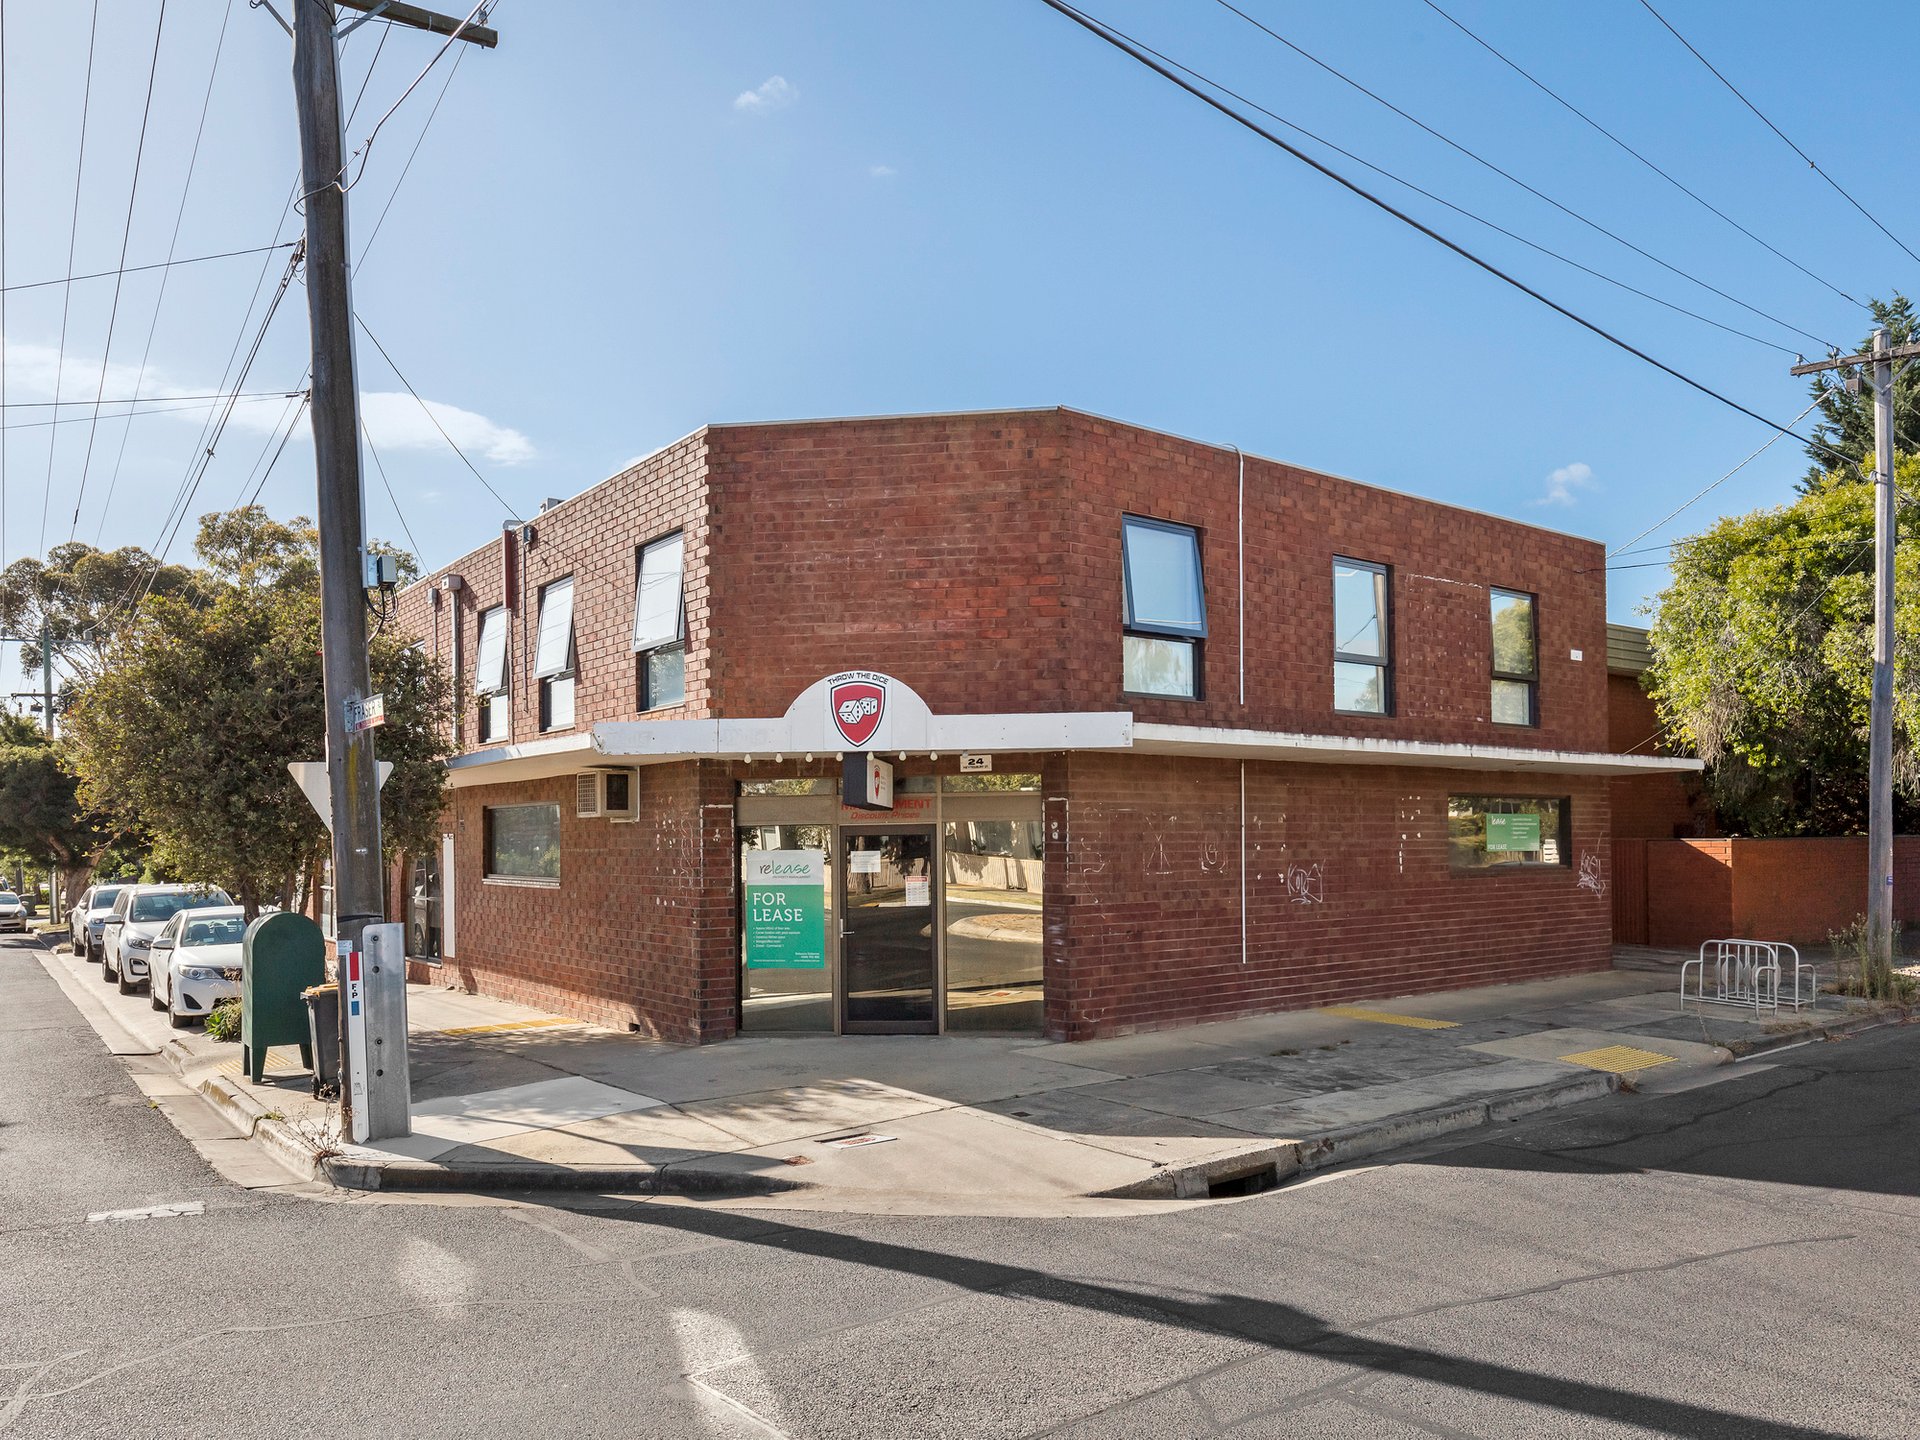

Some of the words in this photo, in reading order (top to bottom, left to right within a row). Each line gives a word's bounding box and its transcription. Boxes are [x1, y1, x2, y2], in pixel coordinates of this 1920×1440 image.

[827, 673, 855, 685] THROW
[872, 674, 889, 685] DICE
[968, 758, 984, 766] 24
[760, 860, 811, 875] release
[753, 892, 786, 906] FOR
[753, 908, 803, 922] LEASE
